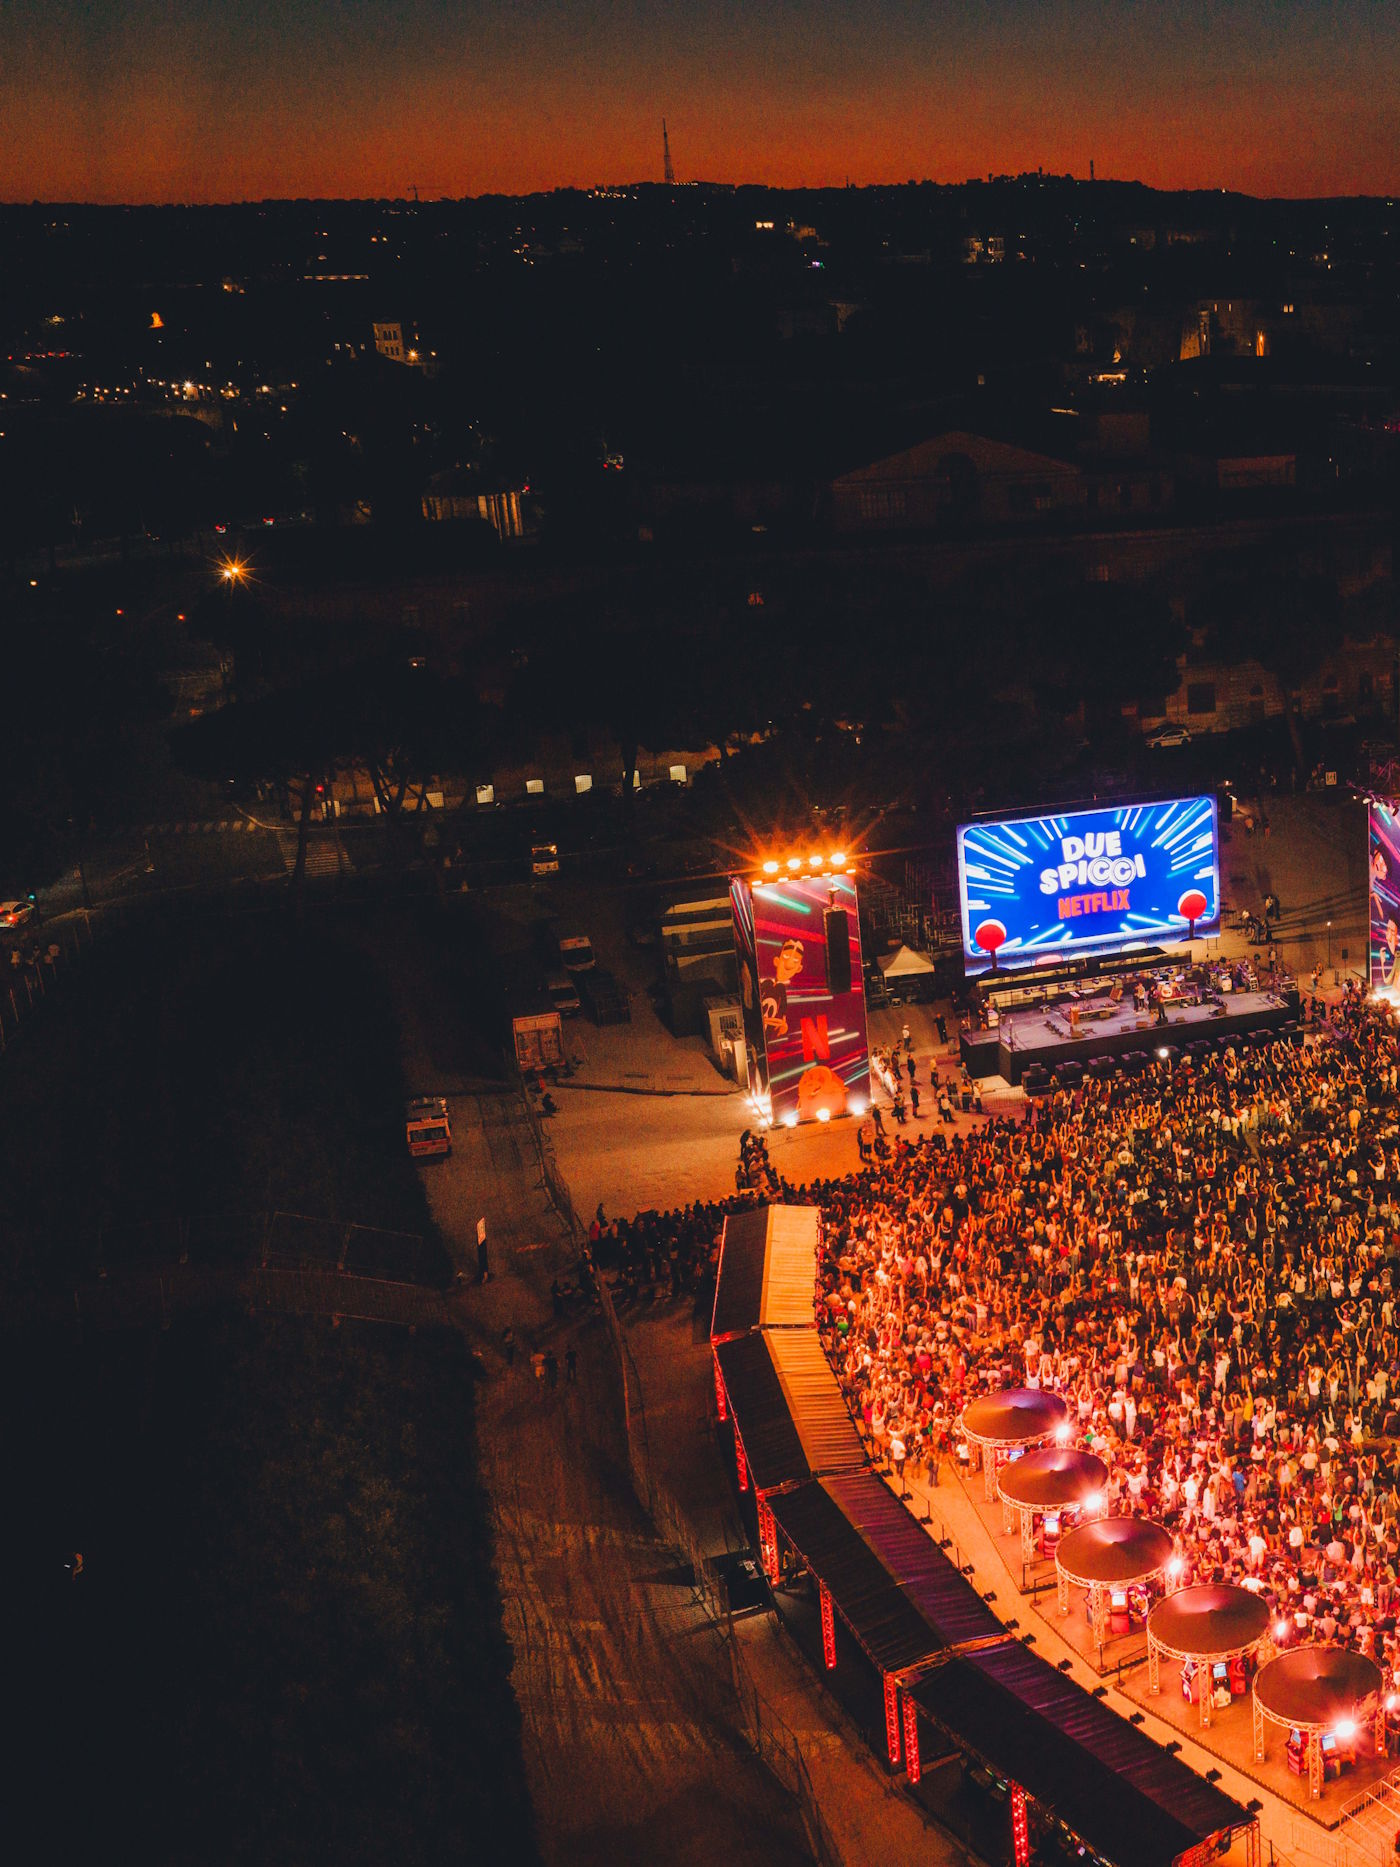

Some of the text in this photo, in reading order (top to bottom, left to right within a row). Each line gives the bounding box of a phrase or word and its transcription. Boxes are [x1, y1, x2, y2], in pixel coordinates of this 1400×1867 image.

[1061, 831, 1121, 863] DUE
[1039, 854, 1146, 894] SPICCI
[1058, 890, 1130, 919] NETFLIX
[801, 1014, 830, 1062] N
